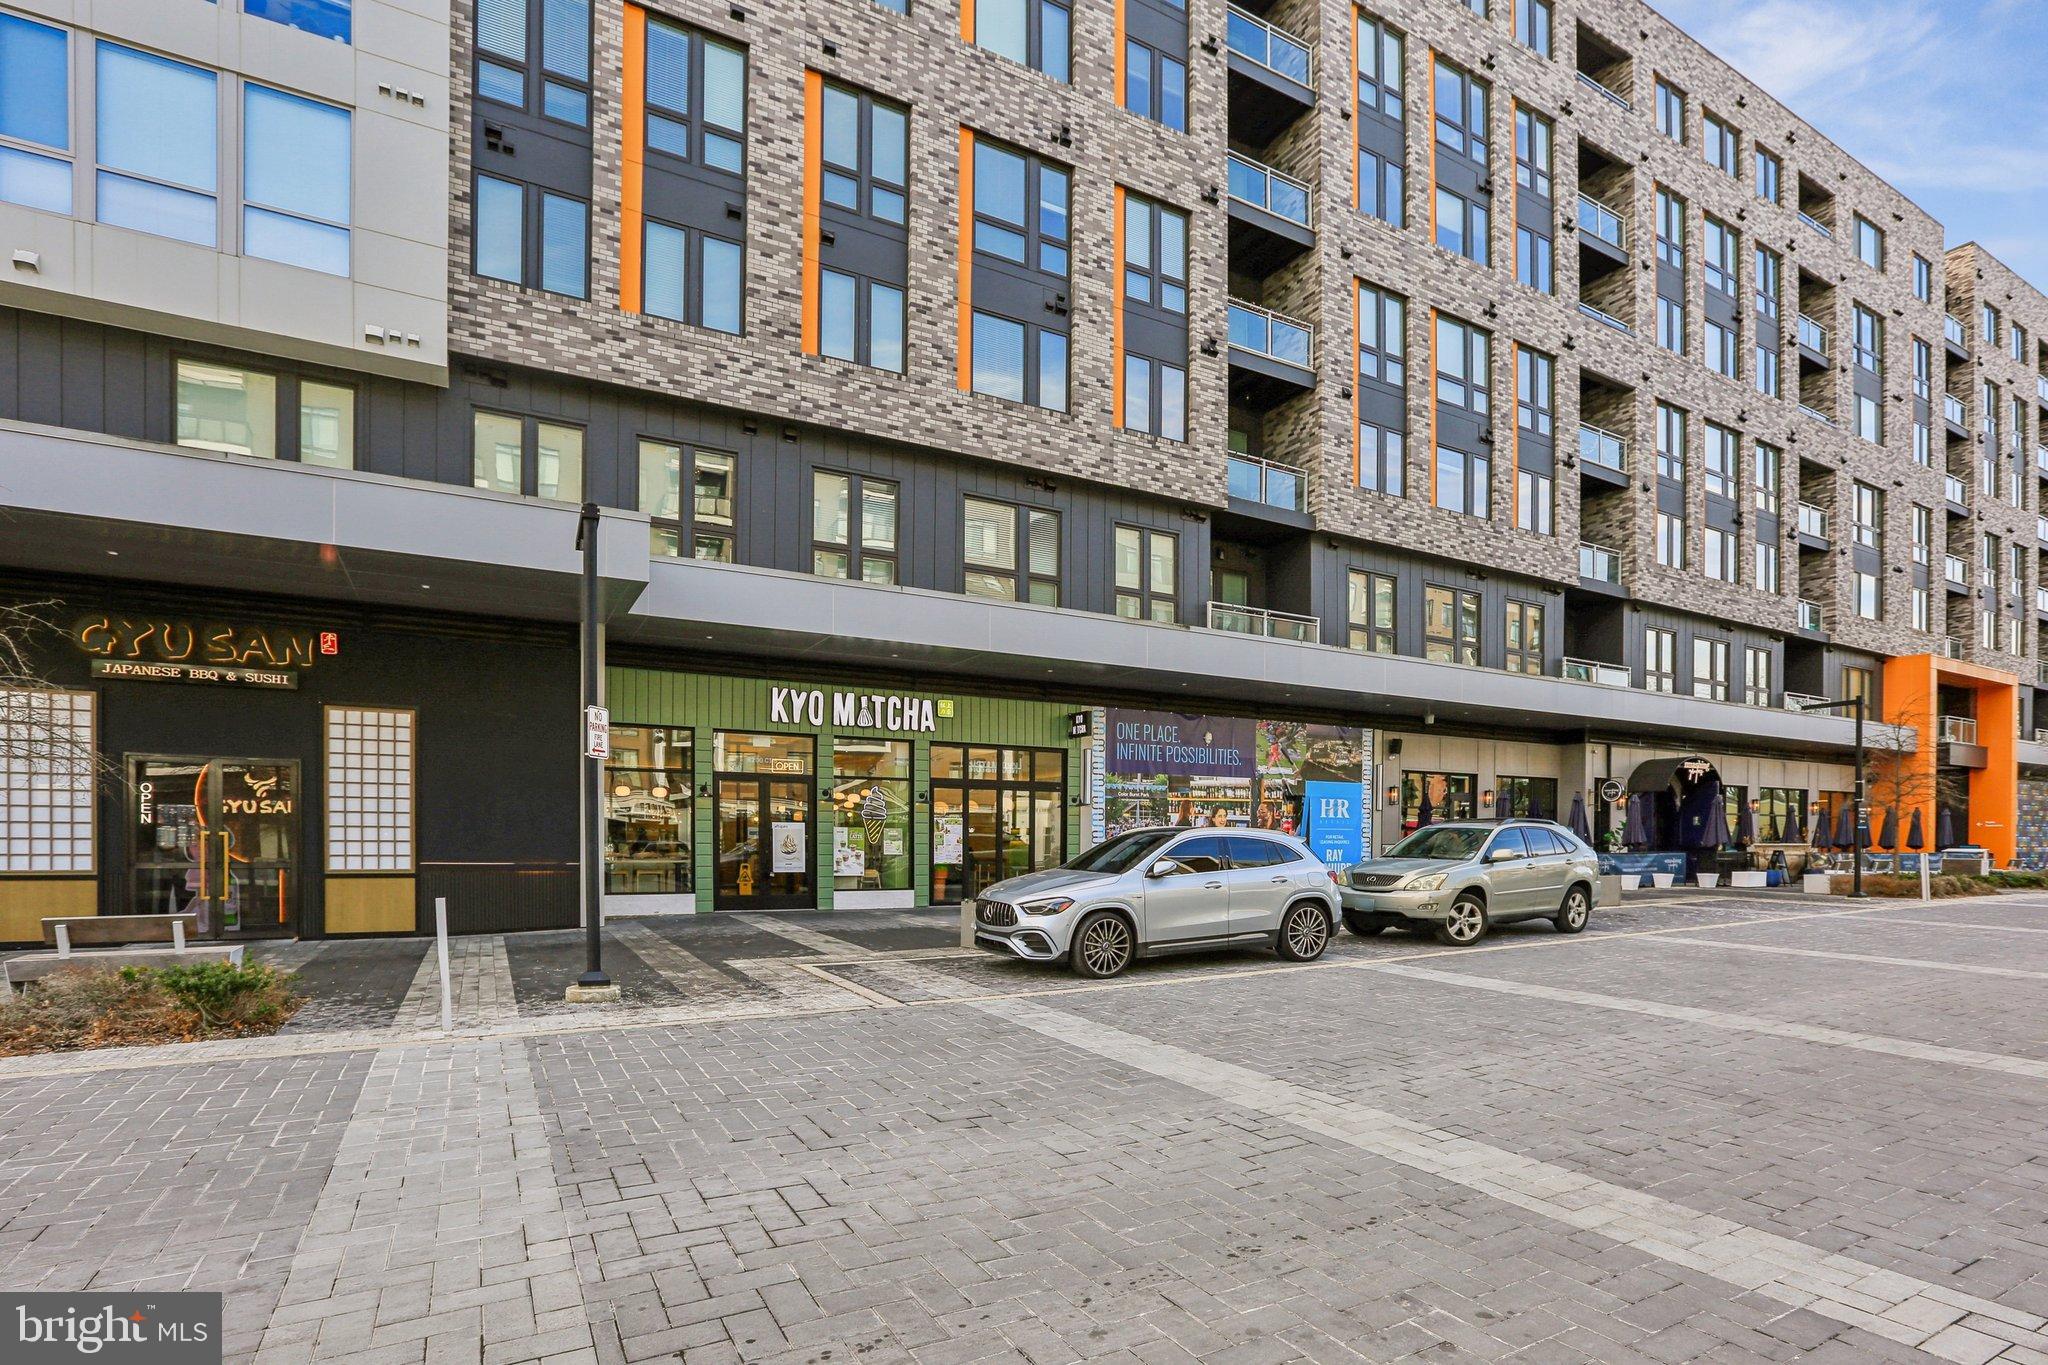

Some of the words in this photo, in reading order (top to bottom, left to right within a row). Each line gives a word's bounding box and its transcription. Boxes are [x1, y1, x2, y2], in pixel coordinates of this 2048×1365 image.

[80, 618, 193, 660] GYU
[206, 624, 314, 667] SAN
[102, 663, 181, 678] JAPANESE
[189, 669, 218, 681] BBQ
[226, 672, 237, 681] &
[245, 673, 289, 685] SUSHI
[771, 687, 824, 726] KYO
[594, 711, 603, 721] NO
[589, 721, 608, 733] PARKING
[1116, 722, 1140, 741] ONE
[1143, 724, 1181, 743] PLACE.
[594, 733, 603, 741] FIRE
[594, 740, 603, 748] LANE
[1116, 743, 1163, 762] INFINITE
[1166, 745, 1242, 766] POSSIBILITIES.
[775, 761, 799, 771] OPEN
[140, 782, 153, 824] OPEN
[259, 799, 292, 814] SA
[1326, 848, 1343, 862] RAY
